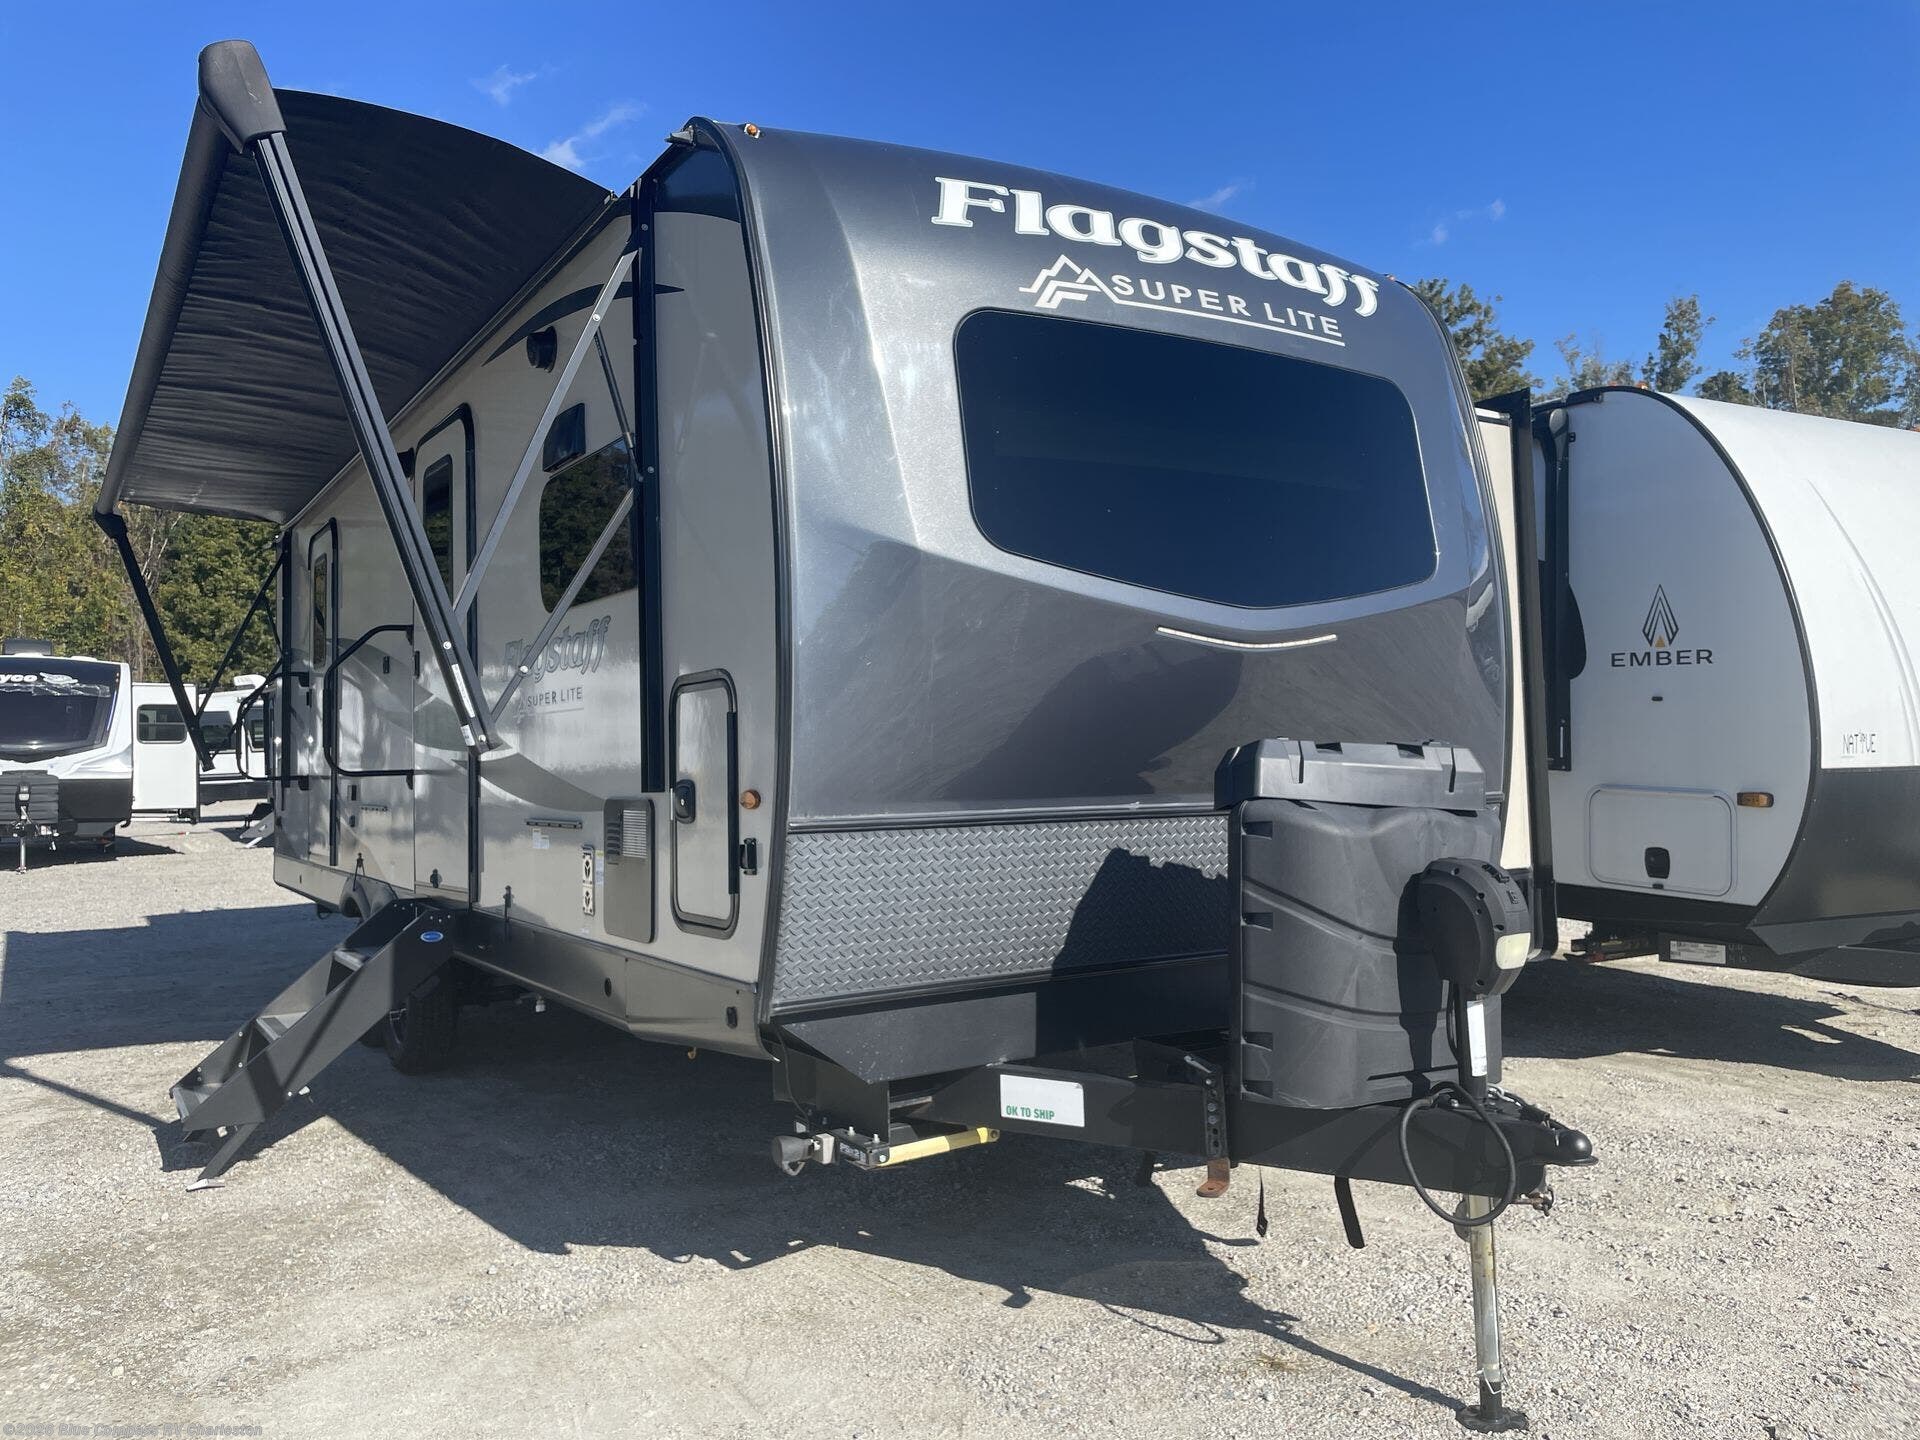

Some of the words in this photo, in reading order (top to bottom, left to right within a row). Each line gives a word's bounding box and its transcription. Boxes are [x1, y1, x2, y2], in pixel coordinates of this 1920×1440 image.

[931, 176, 1380, 317] Flagstaff
[1111, 273, 1250, 317] SUPER
[1263, 301, 1343, 338] LITE
[502, 615, 611, 683] Flgstaff
[1611, 648, 1714, 668] EMBER
[528, 691, 557, 707] SUPER
[560, 687, 583, 702] LITE
[1006, 1105, 1018, 1116] OK
[1020, 1106, 1031, 1117] TO
[1033, 1108, 1055, 1120] SHIP
